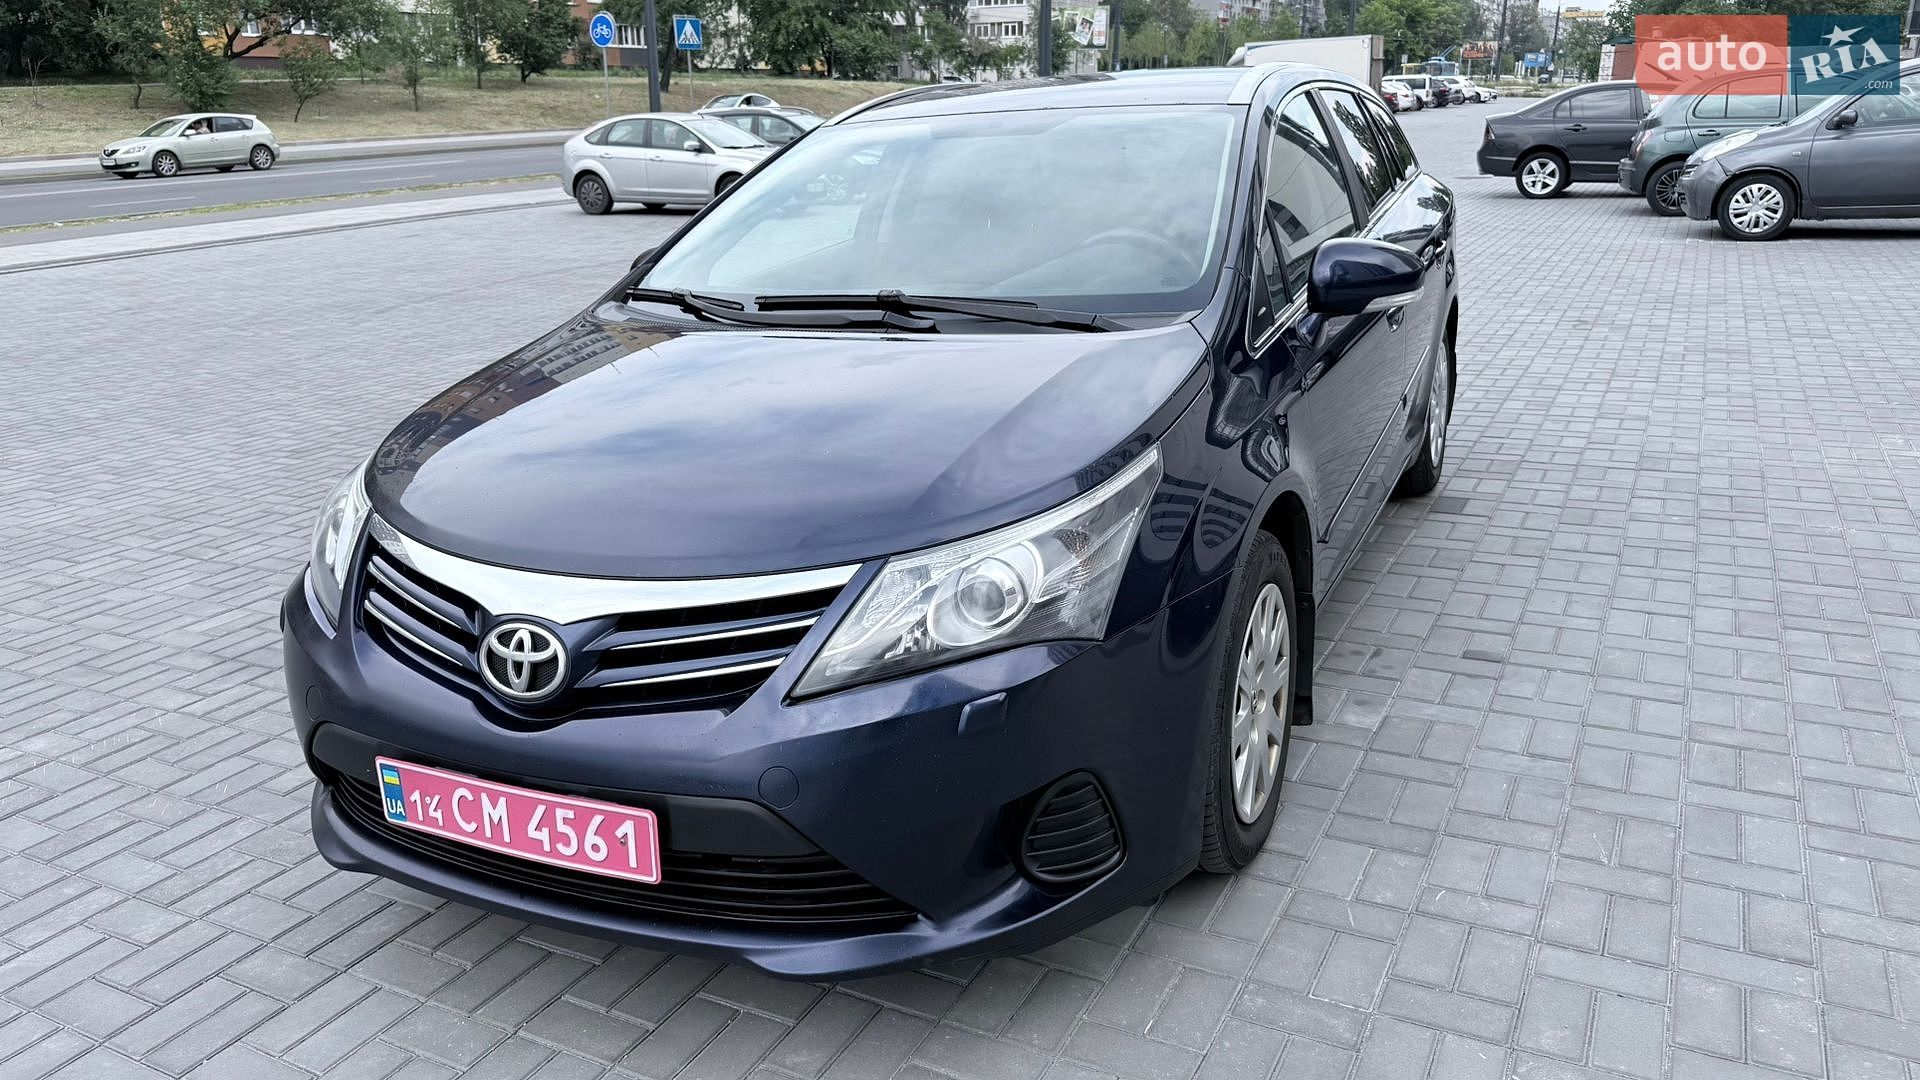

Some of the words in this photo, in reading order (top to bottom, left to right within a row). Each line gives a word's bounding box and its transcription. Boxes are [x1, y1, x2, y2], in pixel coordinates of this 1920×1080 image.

[386, 797, 406, 816] UA
[451, 787, 512, 844] CM
[527, 804, 638, 869] 4561
